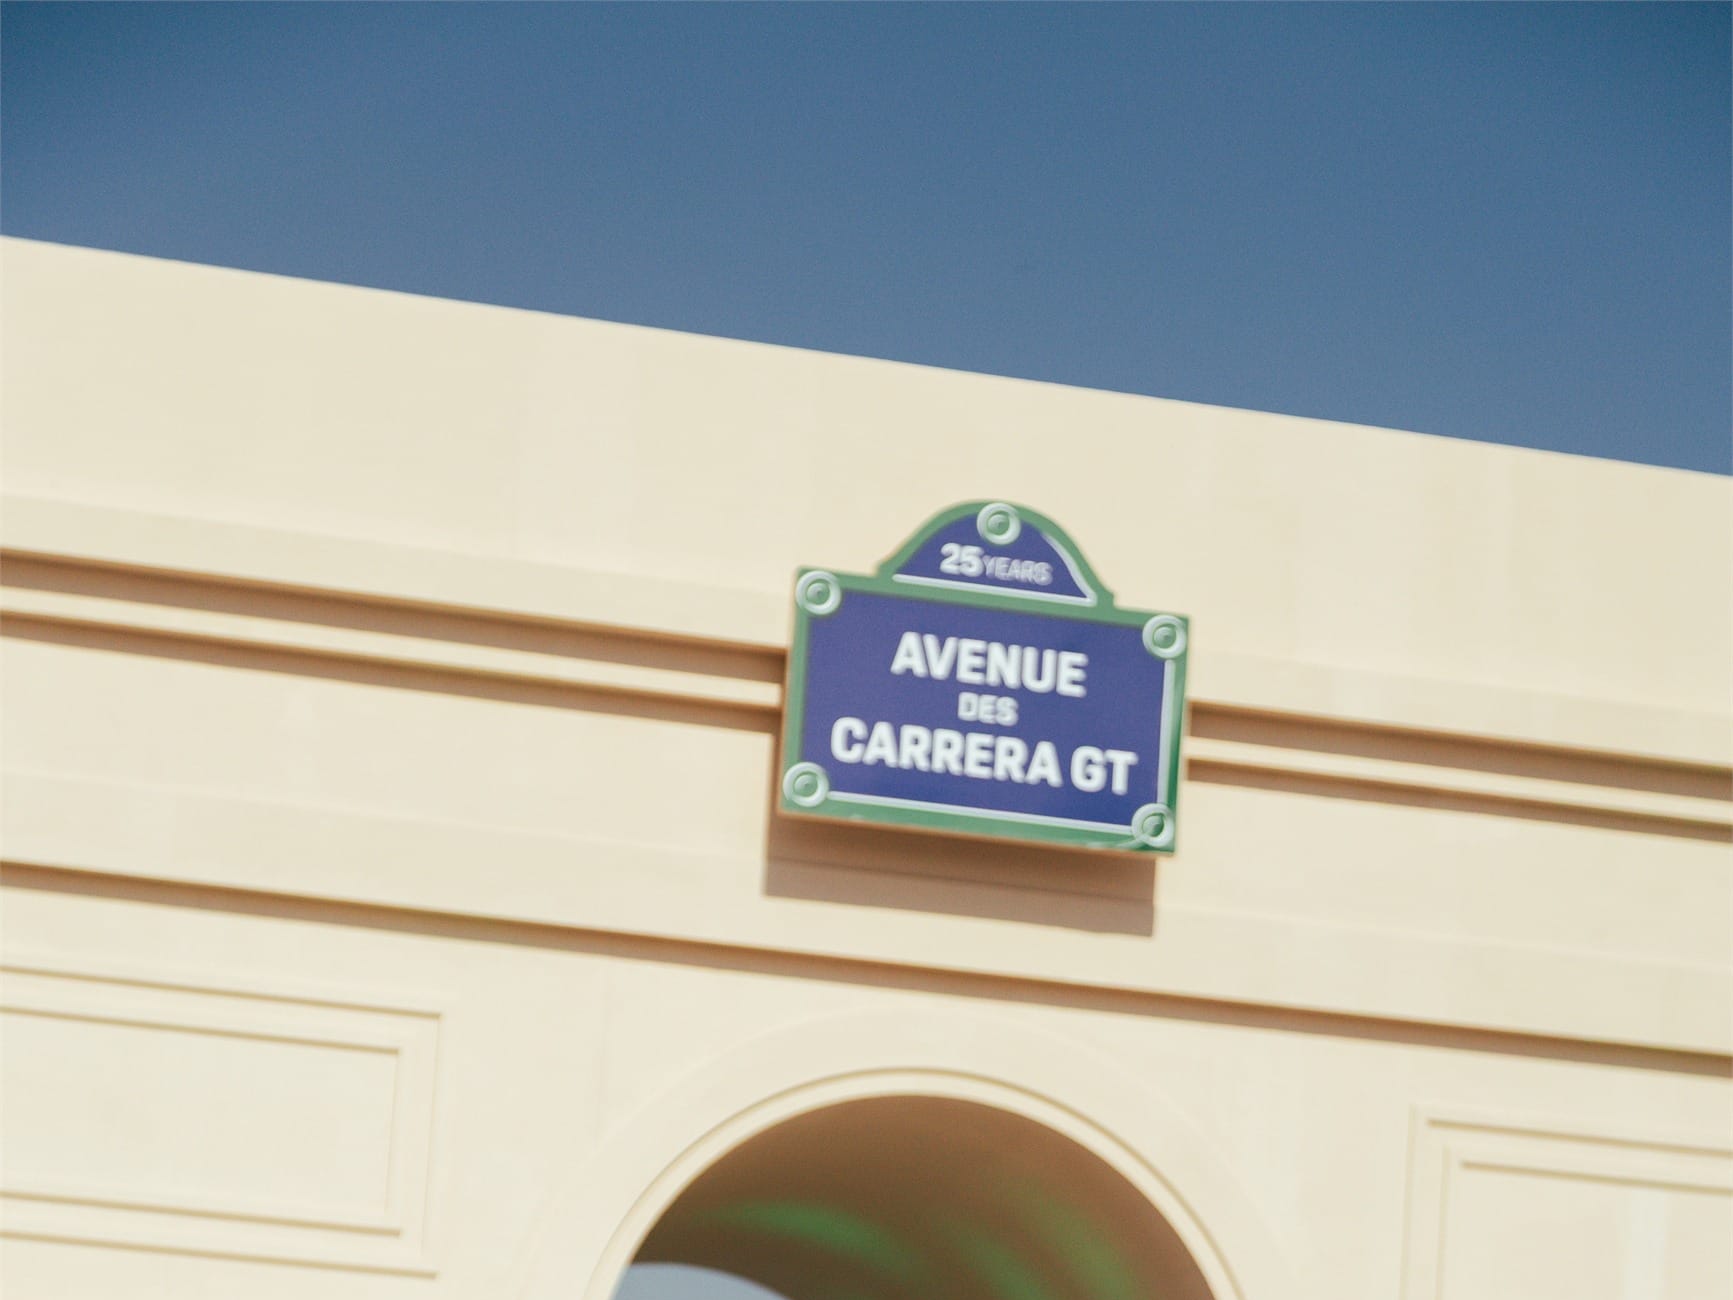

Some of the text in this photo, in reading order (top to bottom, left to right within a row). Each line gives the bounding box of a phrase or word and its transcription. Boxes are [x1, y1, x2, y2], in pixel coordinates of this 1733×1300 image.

[939, 542, 1053, 586] 25 YEARS
[890, 631, 1088, 697] AVENUE
[958, 692, 1018, 727] DES
[830, 716, 1138, 796] CARRERA GT
